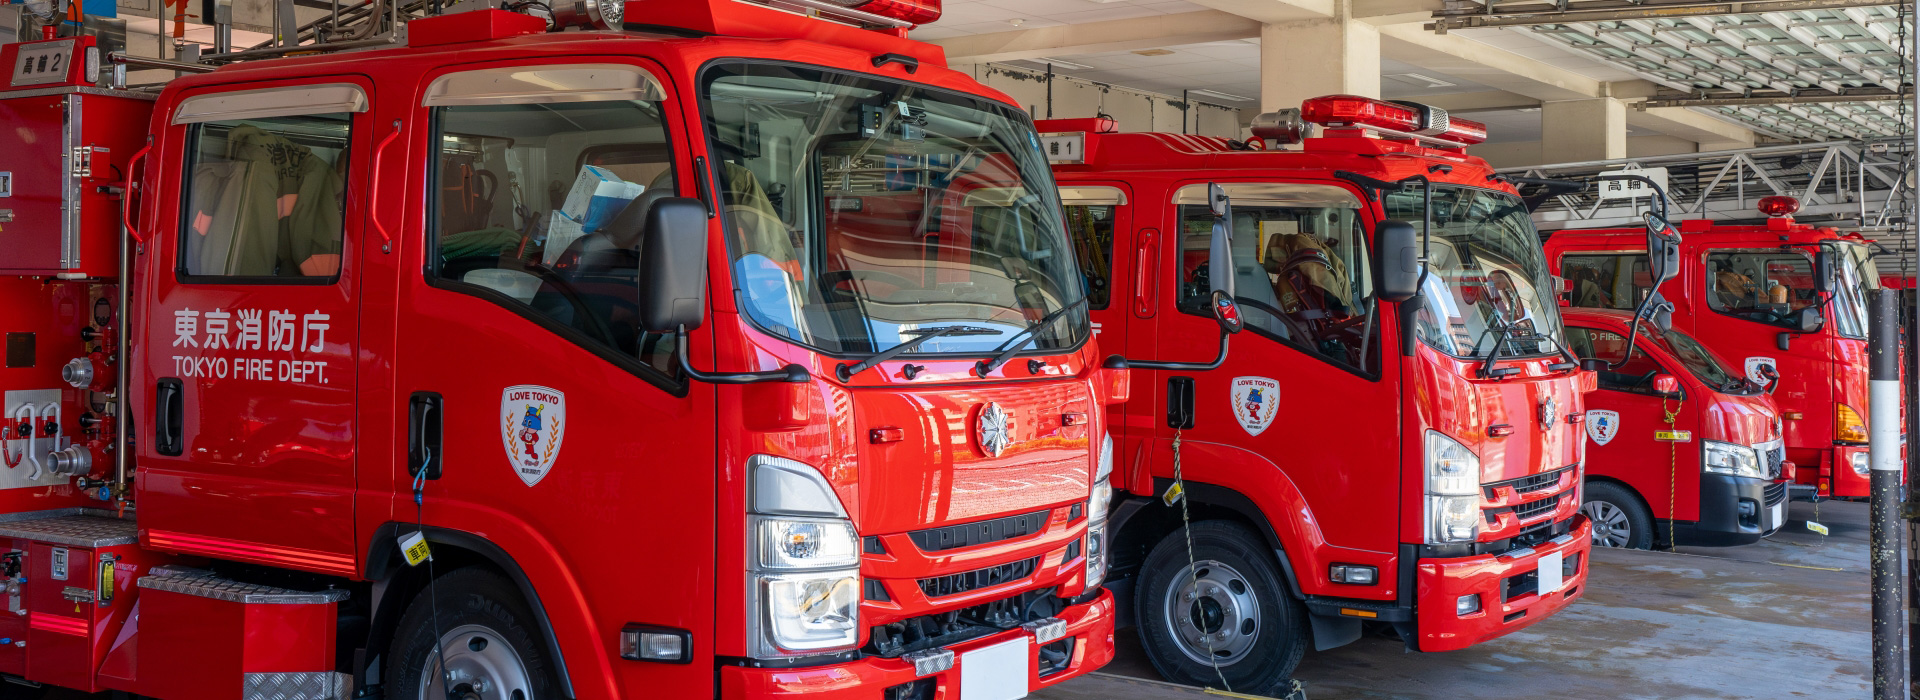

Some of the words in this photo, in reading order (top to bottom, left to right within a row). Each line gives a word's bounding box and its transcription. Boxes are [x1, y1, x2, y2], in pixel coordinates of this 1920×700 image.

[172, 307, 331, 353] 東京消防庁
[1600, 332, 1621, 341] FIRE
[172, 355, 228, 379] TOKYO
[233, 358, 273, 381] FIRE
[278, 360, 329, 384] DEPT.
[1255, 380, 1275, 389] TOKYO
[510, 391, 530, 401] LOVE
[532, 391, 559, 405] TOKYO
